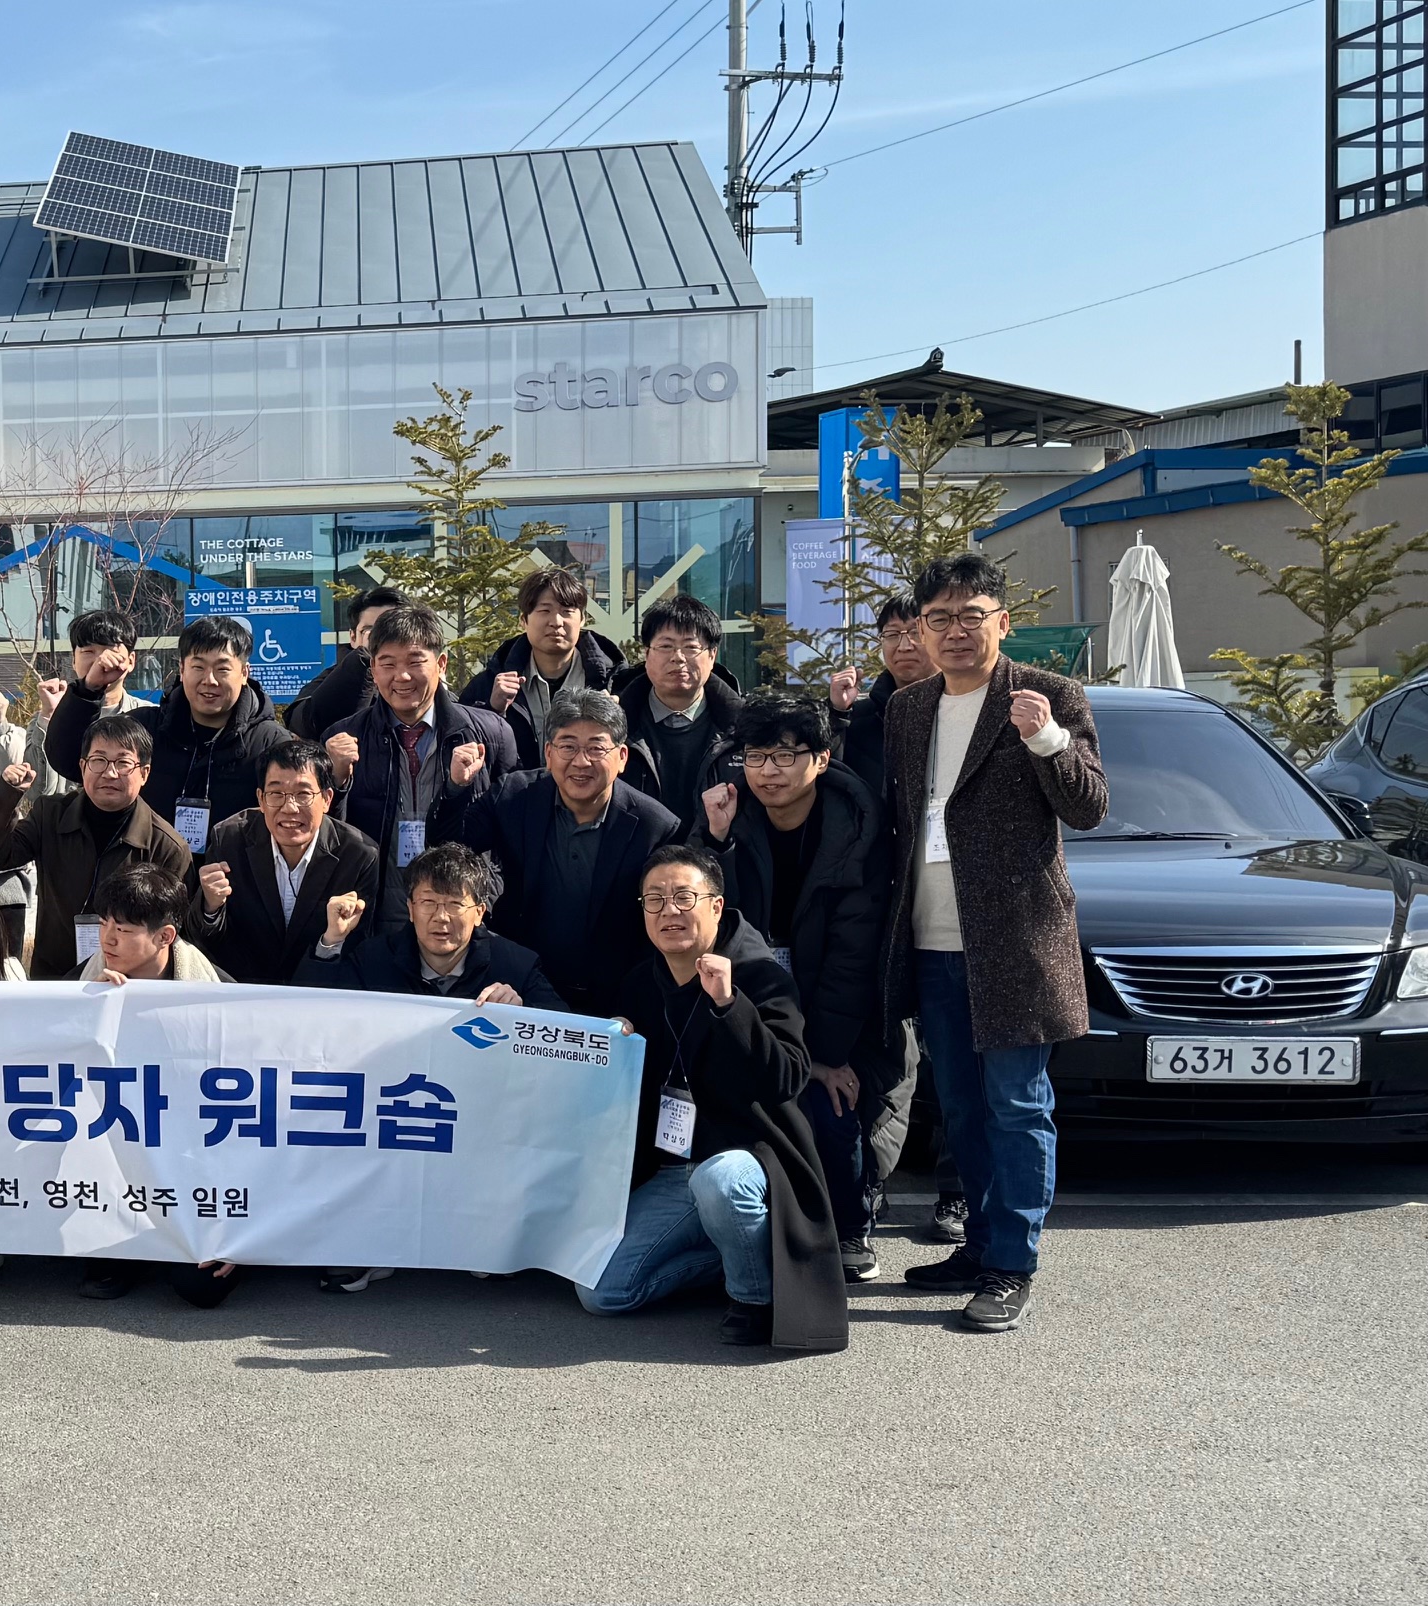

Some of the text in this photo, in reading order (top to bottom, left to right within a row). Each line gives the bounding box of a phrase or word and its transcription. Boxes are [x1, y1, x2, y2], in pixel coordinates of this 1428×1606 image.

[513, 361, 739, 412] starco
[199, 537, 284, 550] THE COTTAGE
[792, 541, 824, 550] COFFEE
[200, 550, 313, 563] UNDER THE STARS
[792, 551, 837, 560] BEVERAGE
[792, 561, 817, 569] FOOD
[187, 589, 317, 607] 장애인전용주차구역
[514, 1021, 610, 1051] 경상북도
[513, 1043, 609, 1066] GYEONGSANGBUK-DO
[1169, 1046, 1336, 1075] 63거 3612
[198, 1067, 458, 1154] 워크숍
[42, 1180, 108, 1213] 영천,
[122, 1184, 179, 1218] 성주
[192, 1187, 249, 1219] 일원
